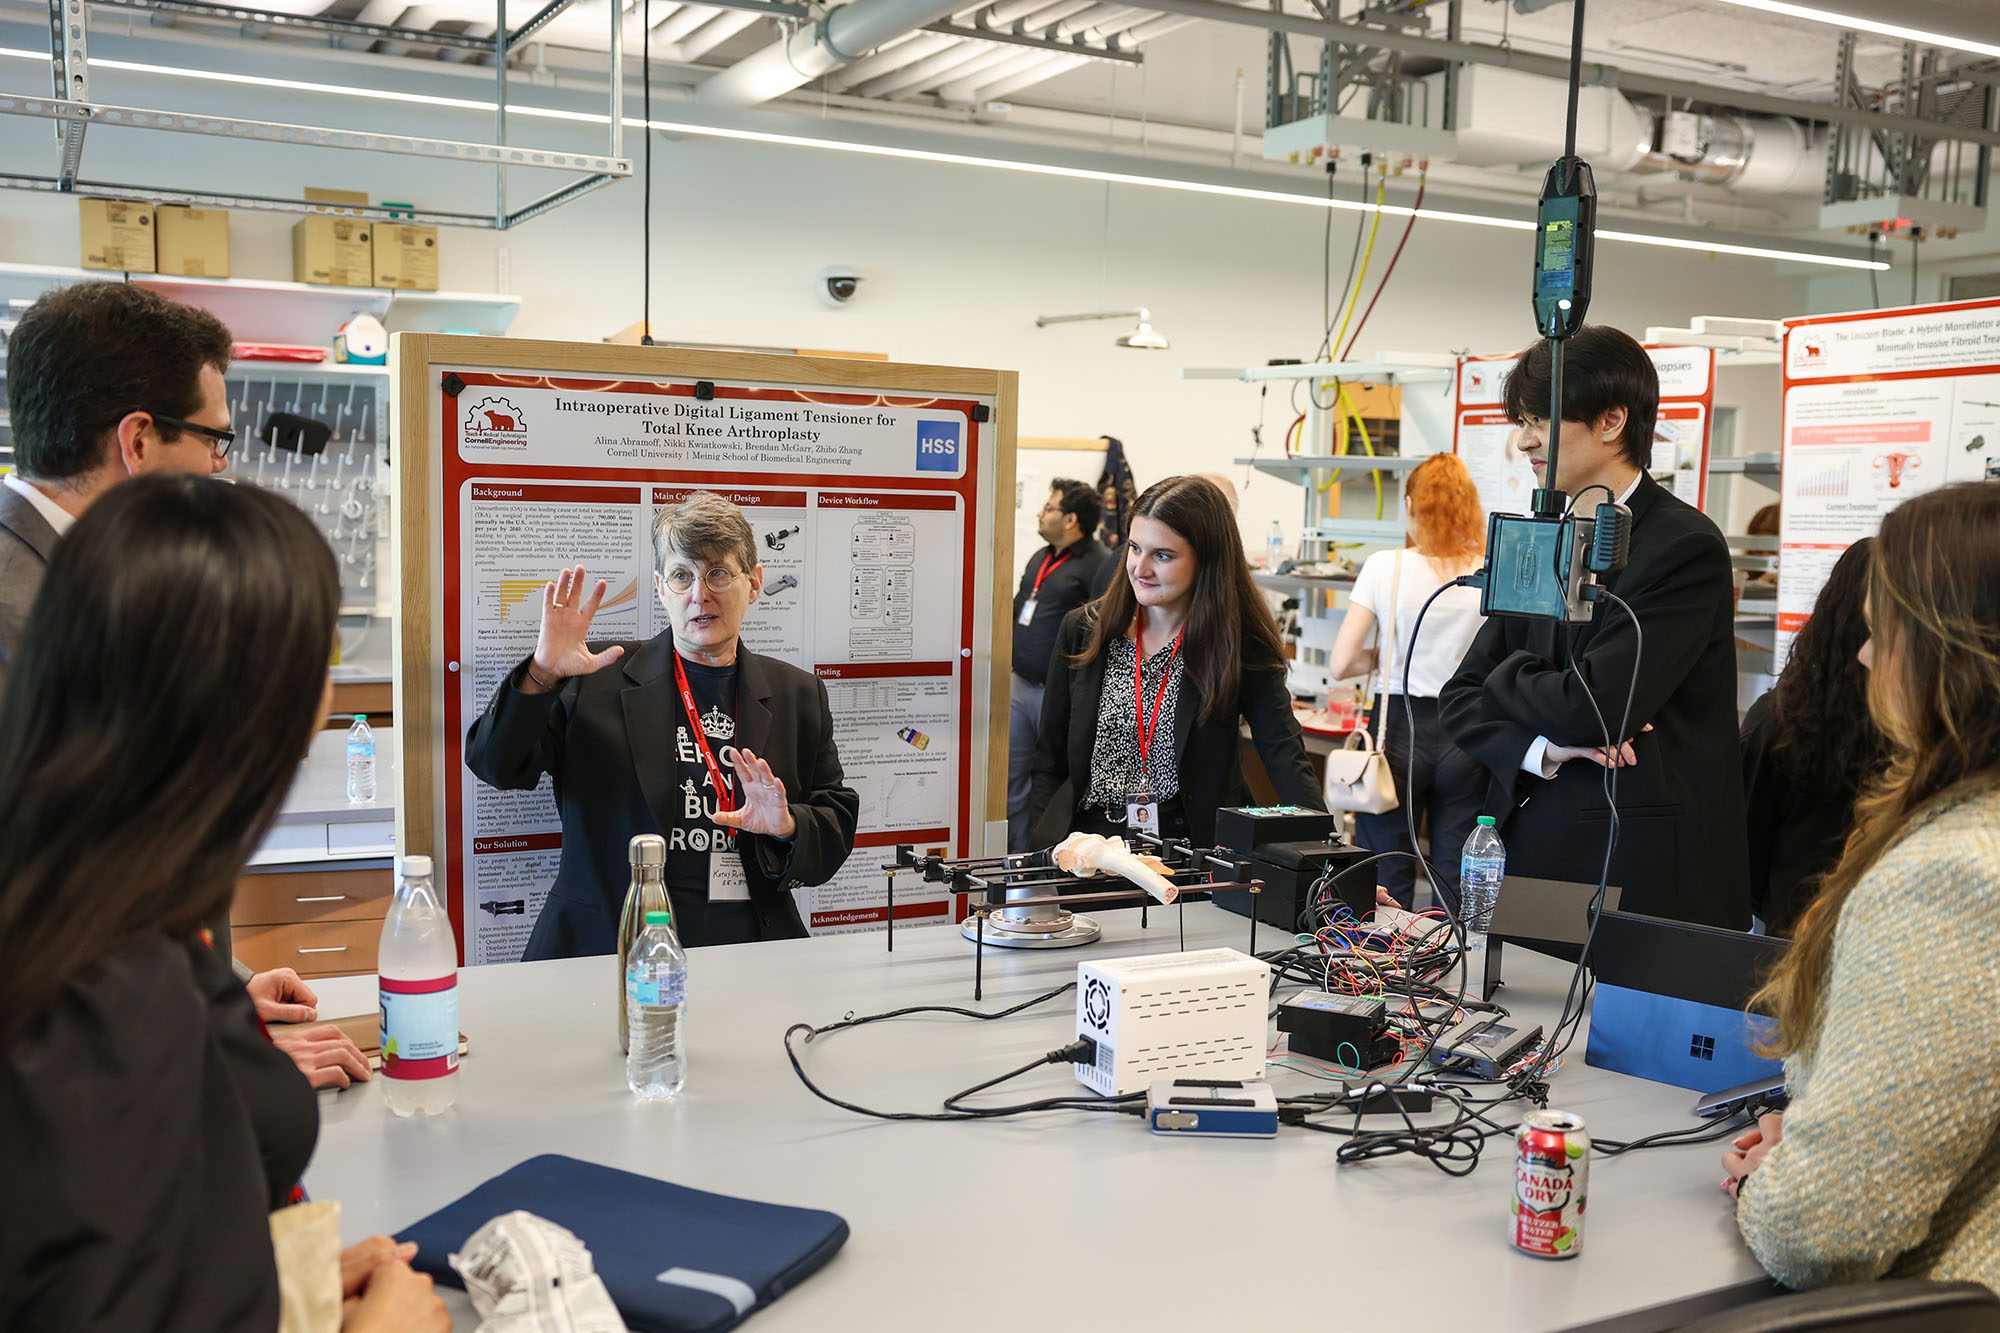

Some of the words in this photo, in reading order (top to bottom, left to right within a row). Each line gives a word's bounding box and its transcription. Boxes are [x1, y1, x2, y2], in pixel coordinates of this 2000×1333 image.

[1916, 325, 1942, 336] Hybrid
[1944, 319, 1994, 332] Morcellator
[1876, 340, 1915, 353] Minimally
[1917, 338, 1949, 349] Invasive
[1951, 335, 1981, 346] Fibroid
[1983, 334, 2000, 344] Trea
[555, 397, 670, 416] Intraoperative
[674, 403, 725, 420] Digital
[729, 406, 799, 424] Ligament
[803, 410, 873, 425] Tensioner
[877, 413, 897, 426] for
[642, 420, 681, 435] Total
[686, 423, 723, 437] Knee
[727, 425, 820, 443] Arthroplasty
[464, 437, 527, 447] CornellEngineering
[594, 436, 618, 446] Alina
[620, 437, 662, 447] Abramoff,
[664, 439, 686, 448] Nikki
[688, 440, 743, 451] Kwiatkowski,
[745, 442, 779, 452] Brendan
[815, 444, 837, 454] Zhibo
[838, 445, 862, 456] Zhang
[921, 438, 955, 455] HSS
[607, 448, 638, 458] Cornell
[640, 449, 683, 461] University
[692, 451, 720, 461] Meinig
[722, 452, 749, 461] School
[750, 453, 759, 462] of
[760, 453, 803, 464] Biomedical
[805, 456, 852, 466] Engineering
[473, 487, 523, 498] Background
[653, 492, 674, 501] Main
[734, 494, 761, 504] Design
[819, 496, 843, 505] Device
[845, 496, 879, 505] Workflow
[525, 513, 550, 521] procedure
[538, 506, 556, 514] leading
[604, 507, 632, 515] arthroplasty
[475, 652, 495, 660] surgical
[816, 668, 841, 677] Testing
[683, 690, 694, 711] Cornell
[705, 751, 717, 770] Cornell
[702, 770, 734, 791] AN
[475, 842, 492, 850] Our
[494, 840, 528, 849] Solution
[491, 857, 508, 865] project
[812, 912, 879, 924] Acknowledgements
[485, 938, 508, 946] Quantify
[1515, 1167, 1573, 1191] CANADA
[1524, 1186, 1557, 1203] DRY
[1521, 1222, 1555, 1237] WATER
